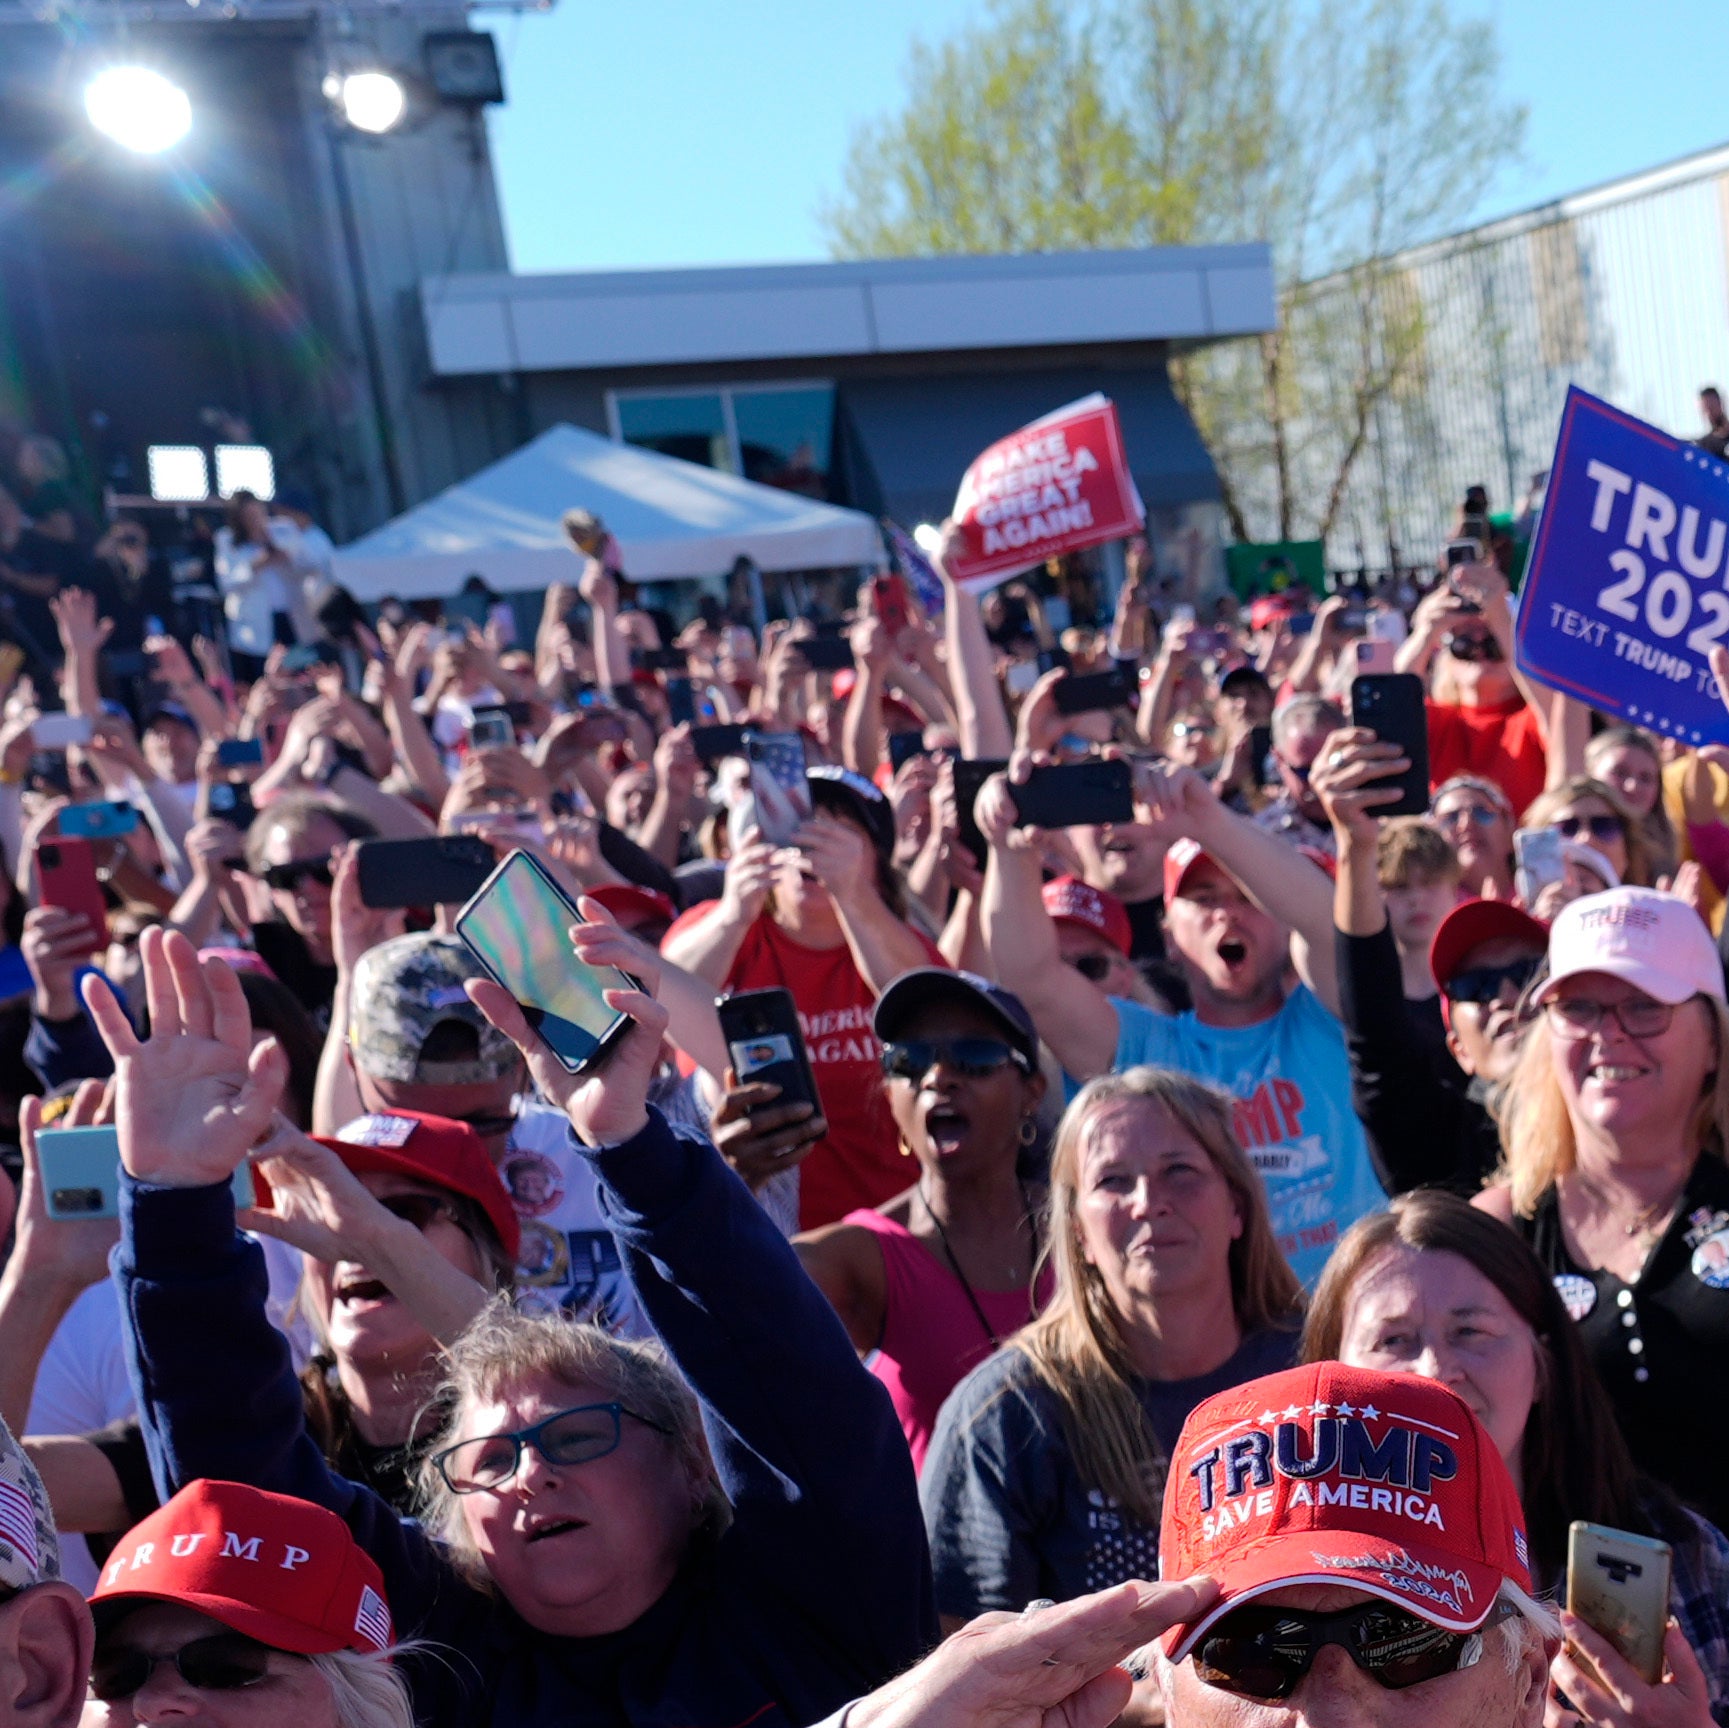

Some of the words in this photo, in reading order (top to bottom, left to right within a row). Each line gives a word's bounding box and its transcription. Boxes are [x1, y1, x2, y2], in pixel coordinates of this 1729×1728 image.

[977, 476, 1083, 527] GREAT
[983, 500, 1096, 555] AGAIN!
[1550, 602, 1611, 649] TEXT
[1614, 631, 1693, 684] TRUMP
[1190, 1416, 1459, 1513] TRUMP
[1202, 1488, 1275, 1541] SAVE
[1289, 1480, 1446, 1532] AMERICA
[106, 1530, 310, 1587] TRUMP
